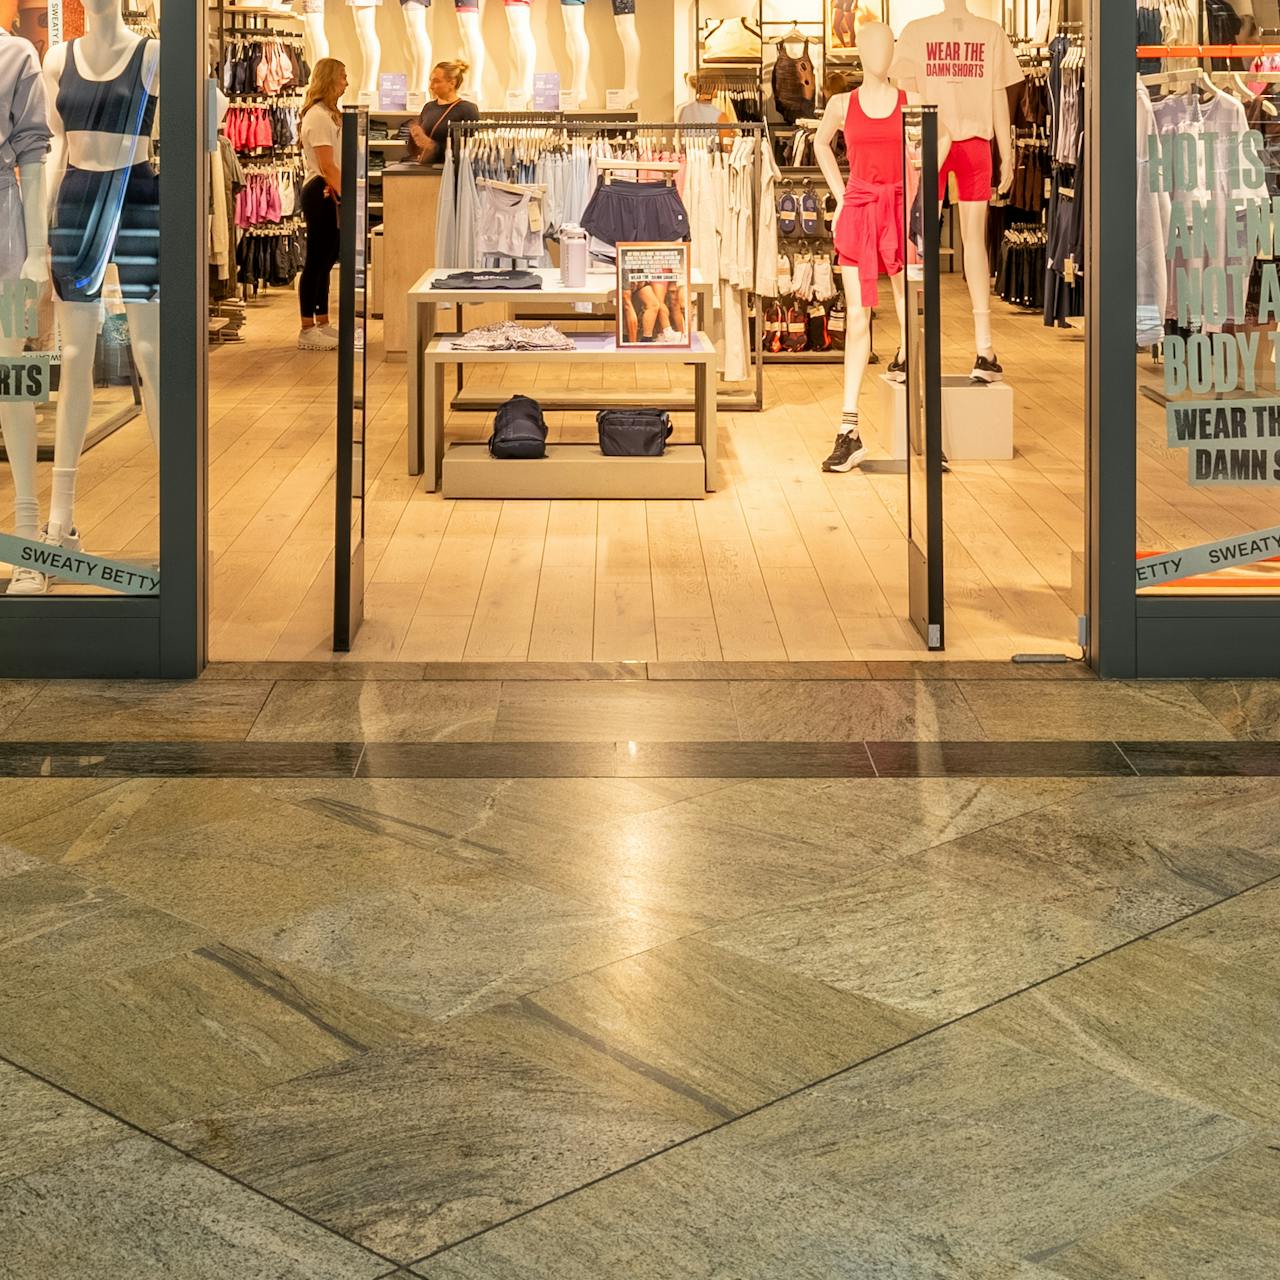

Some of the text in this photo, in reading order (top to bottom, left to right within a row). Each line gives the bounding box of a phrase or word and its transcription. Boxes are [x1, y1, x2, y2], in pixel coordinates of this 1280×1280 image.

[926, 42, 985, 62] WEAR THE
[926, 63, 984, 78] DAMN SHORTS
[1147, 129, 1266, 193] HOT IS
[1167, 198, 1218, 260] AN
[1176, 265, 1250, 326] NOT
[1163, 332, 1260, 397] BODY
[1174, 405, 1247, 441] WEAR
[1195, 448, 1267, 481] DAMN
[20, 546, 98, 576] SWEATY
[101, 566, 161, 592] BETTY
[1136, 557, 1182, 581] ETTY
